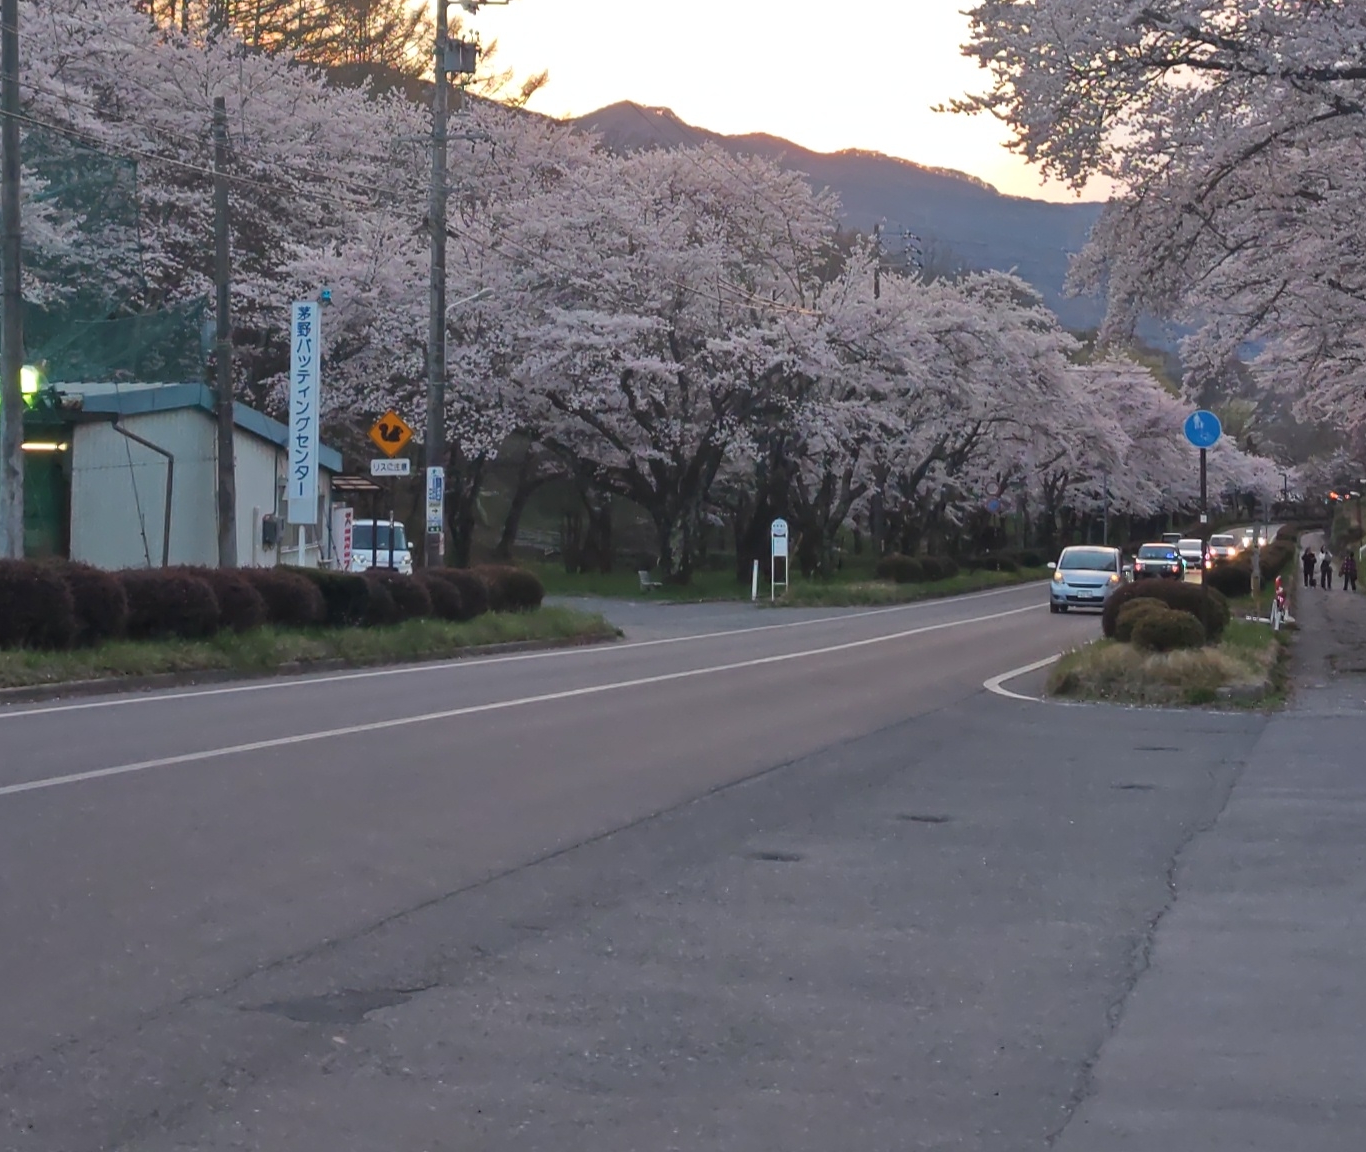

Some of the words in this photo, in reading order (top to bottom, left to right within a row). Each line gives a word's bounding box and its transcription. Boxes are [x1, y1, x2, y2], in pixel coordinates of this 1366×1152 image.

[295, 306, 312, 496] 茅野バッティングセンター
